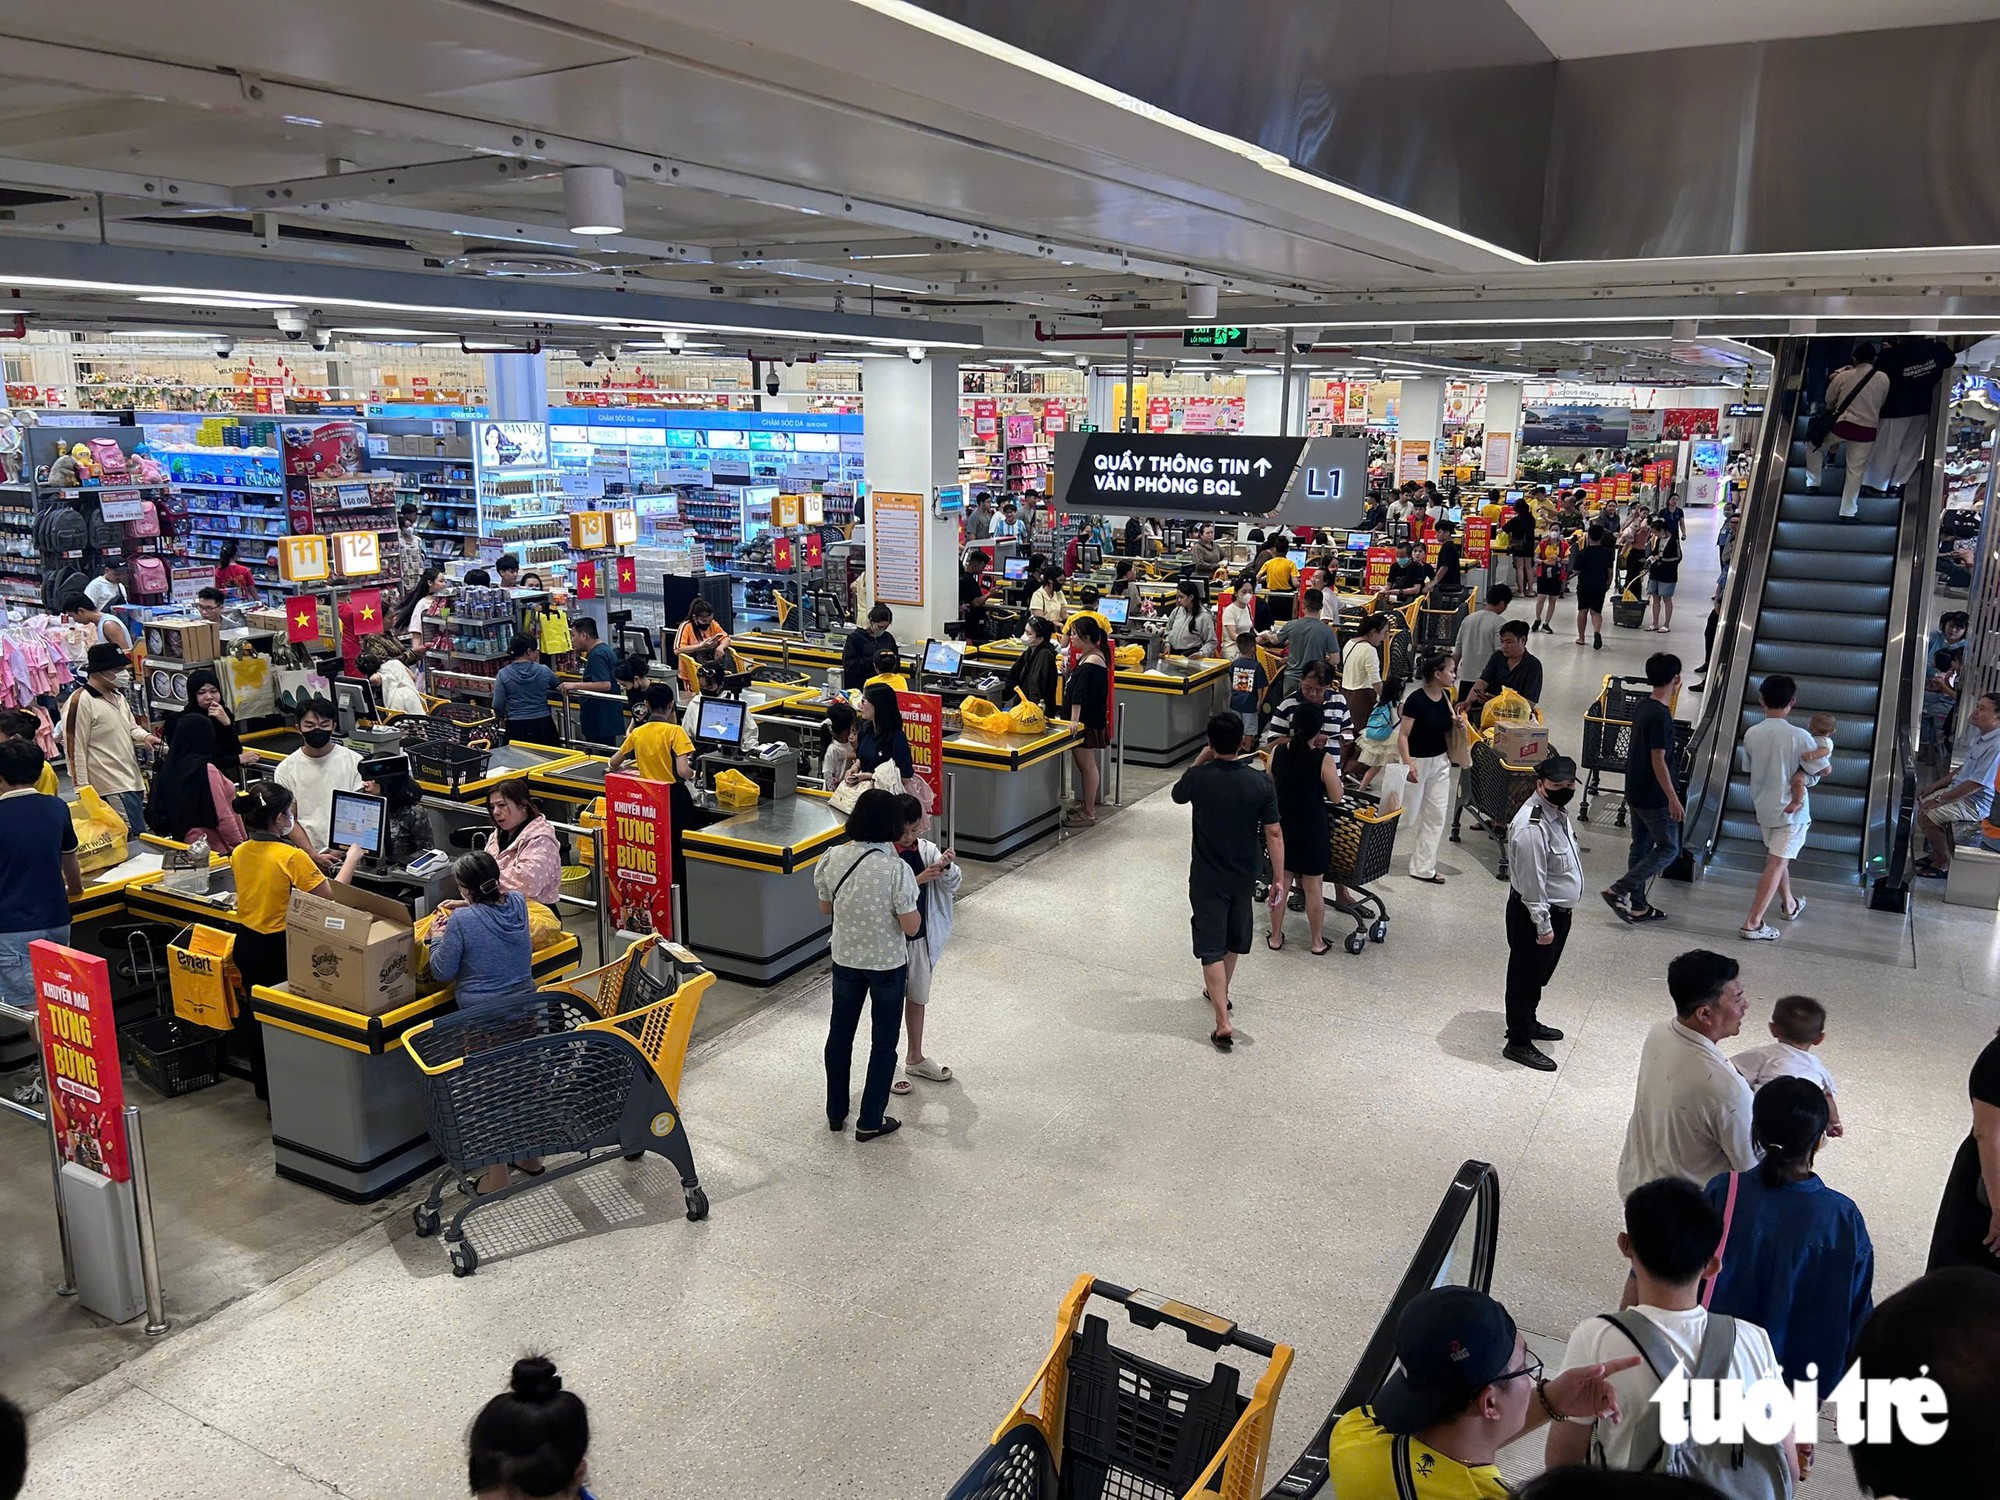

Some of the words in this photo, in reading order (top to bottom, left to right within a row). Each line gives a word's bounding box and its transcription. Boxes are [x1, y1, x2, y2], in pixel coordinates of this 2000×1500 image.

[503, 423, 545, 434] PANTENE
[761, 418, 780, 426] CHĂM
[780, 418, 794, 427] SÓC
[1094, 450, 1145, 471] QUẦY
[1148, 452, 1214, 475] THÔNG
[1218, 459, 1250, 475] TIN
[1093, 474, 1130, 492] VĂN
[1134, 472, 1199, 494] PHÒNG
[1202, 479, 1242, 497] BQL
[1306, 467, 1343, 498] L1
[343, 497, 370, 506] 160.000
[782, 499, 796, 516] 15
[808, 496, 820, 512] 16
[580, 515, 600, 536] 13
[616, 513, 633, 531] 14
[293, 537, 317, 564] 11
[347, 534, 373, 557] 12
[1427, 544, 1442, 553] TƯN
[900, 710, 920, 721] HUYẾN
[920, 712, 932, 723] MÃI
[421, 764, 443, 778] emart
[627, 791, 643, 800] emart
[614, 800, 641, 815] KHUYẾN
[641, 805, 657, 820] MÃI
[616, 816, 655, 846] TƯNG
[616, 842, 657, 875] BỪNG
[311, 951, 341, 969] Sunlight
[379, 954, 408, 984] Sunlight
[55, 969, 73, 983] emart
[42, 980, 73, 1005] KHUYẾN
[73, 990, 90, 1012] MÃI
[47, 1003, 93, 1049] TƯNG
[51, 1040, 99, 1090] BỪNG
